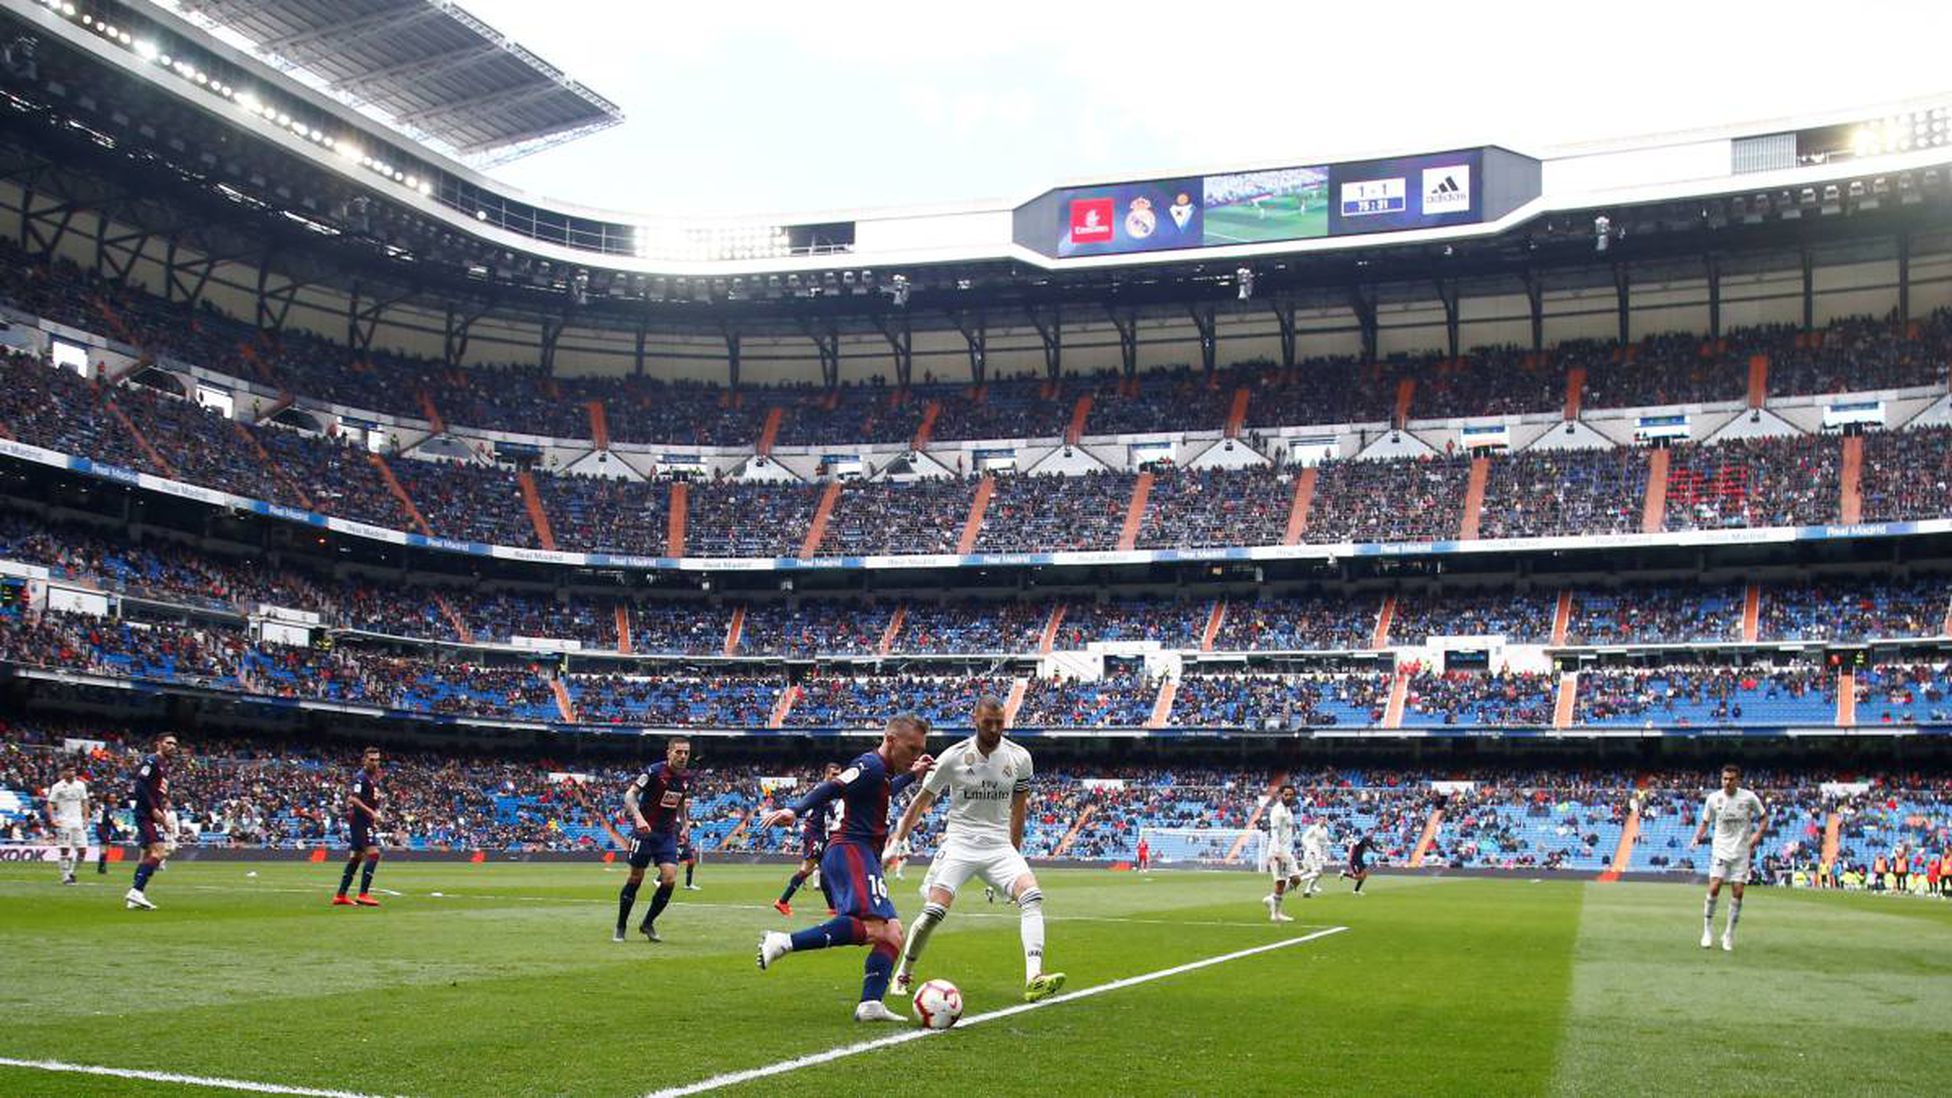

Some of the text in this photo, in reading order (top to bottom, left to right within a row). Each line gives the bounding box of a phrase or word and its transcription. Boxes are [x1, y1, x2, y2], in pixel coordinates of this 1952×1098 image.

[1826, 525, 1886, 536] Real Madrid
[444, 539, 469, 552] Madrid
[532, 551, 563, 563] Madrid
[609, 556, 656, 568] Real Madrid
[796, 558, 842, 567] Real Madrid
[983, 554, 1030, 563] Real Madrid
[868, 874, 888, 898] 16
